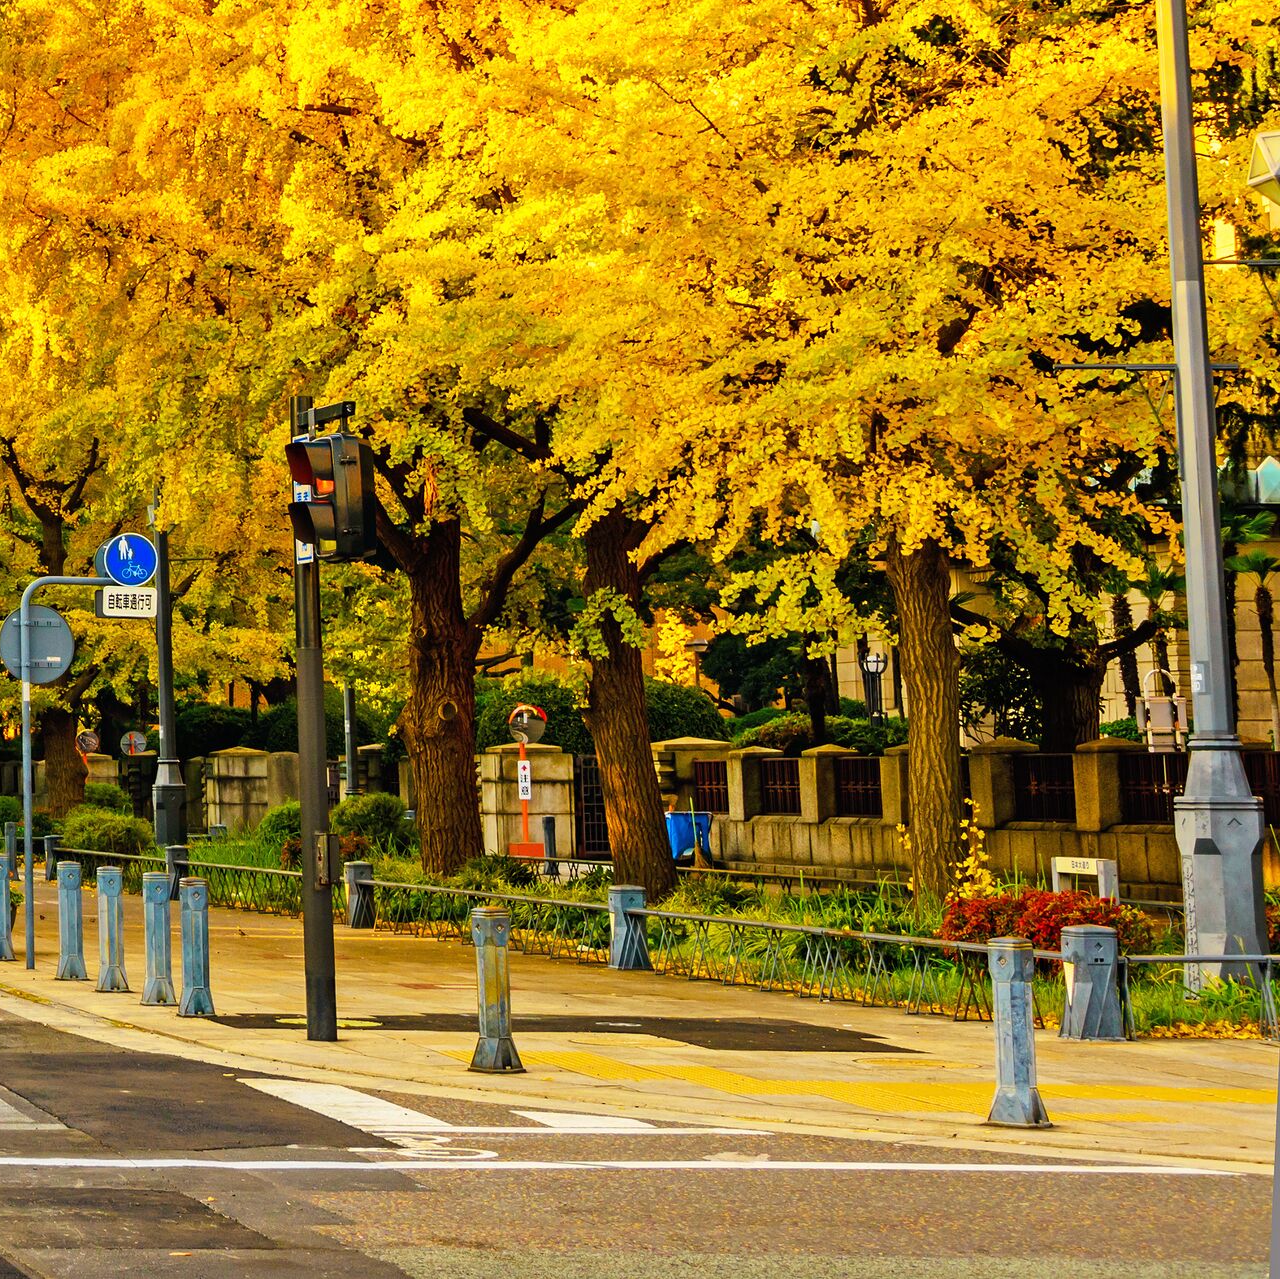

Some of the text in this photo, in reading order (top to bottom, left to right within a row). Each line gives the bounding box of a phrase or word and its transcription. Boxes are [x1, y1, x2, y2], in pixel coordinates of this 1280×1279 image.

[108, 593, 152, 610] 自転車通行可
